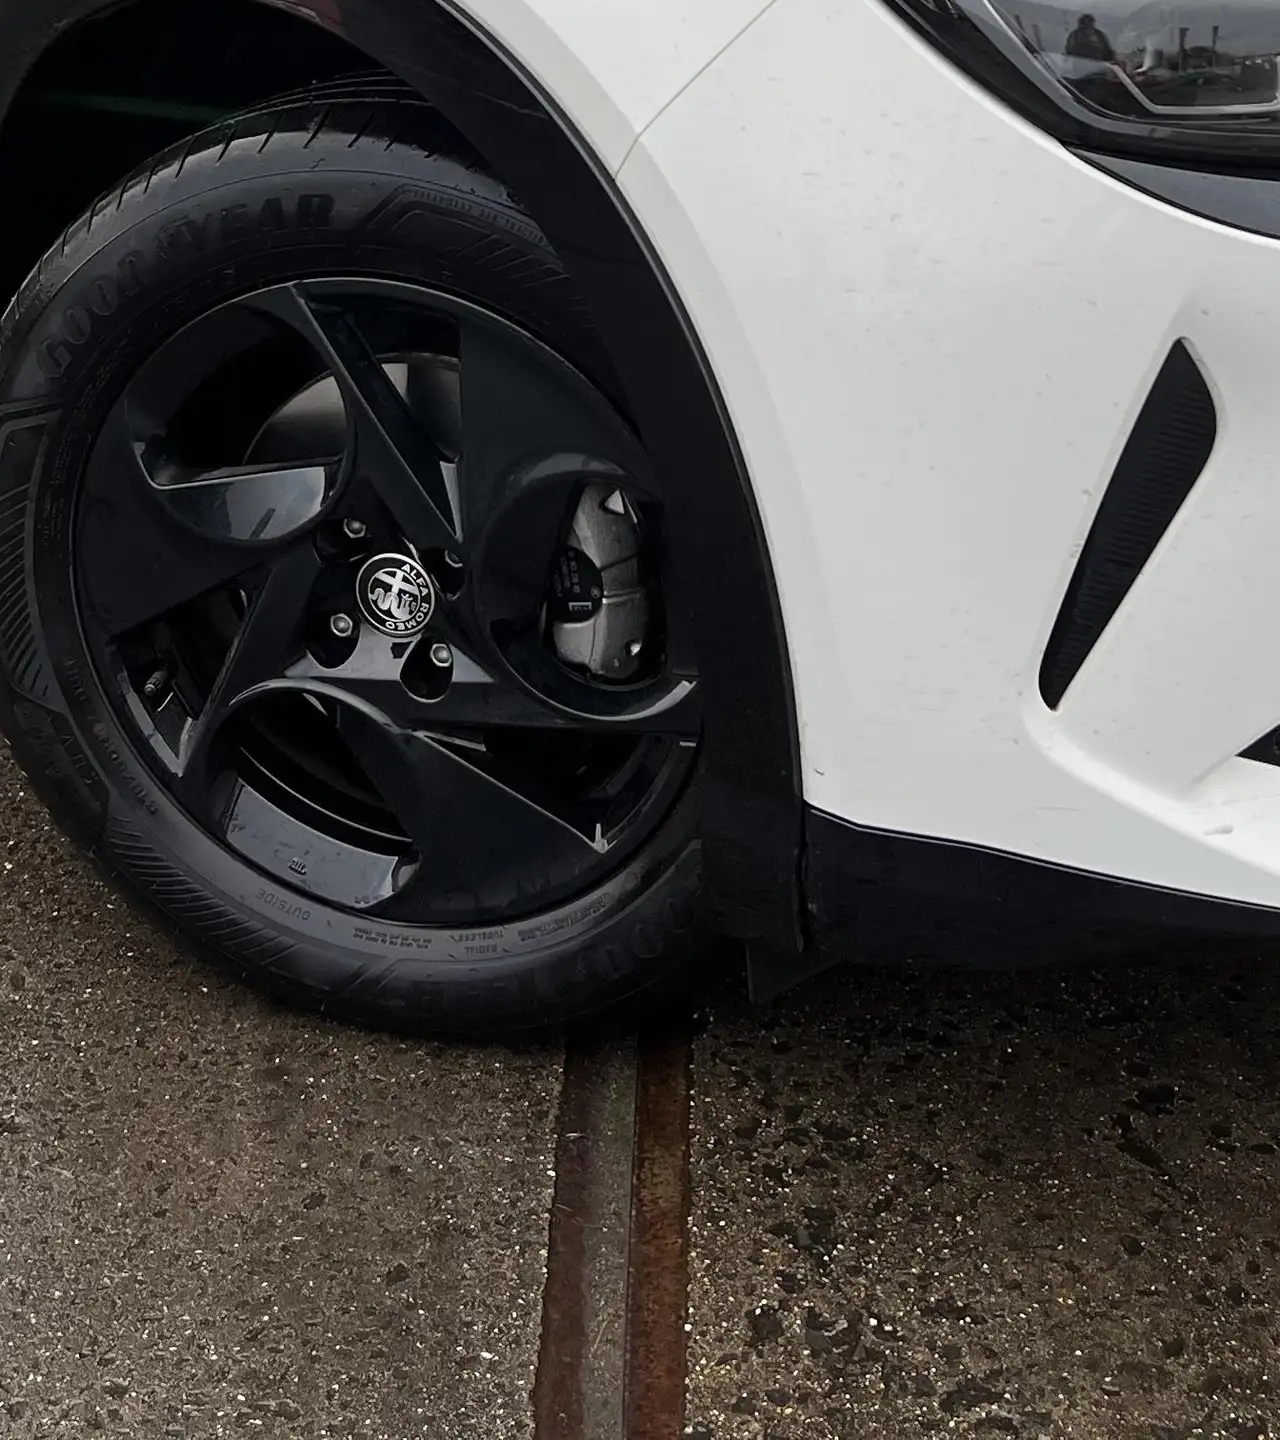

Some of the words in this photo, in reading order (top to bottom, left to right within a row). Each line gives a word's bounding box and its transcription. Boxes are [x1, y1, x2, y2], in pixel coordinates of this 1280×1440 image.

[401, 563, 430, 597] ALFA
[385, 602, 430, 630] ROMEO
[254, 888, 312, 921] OUTSIDE
